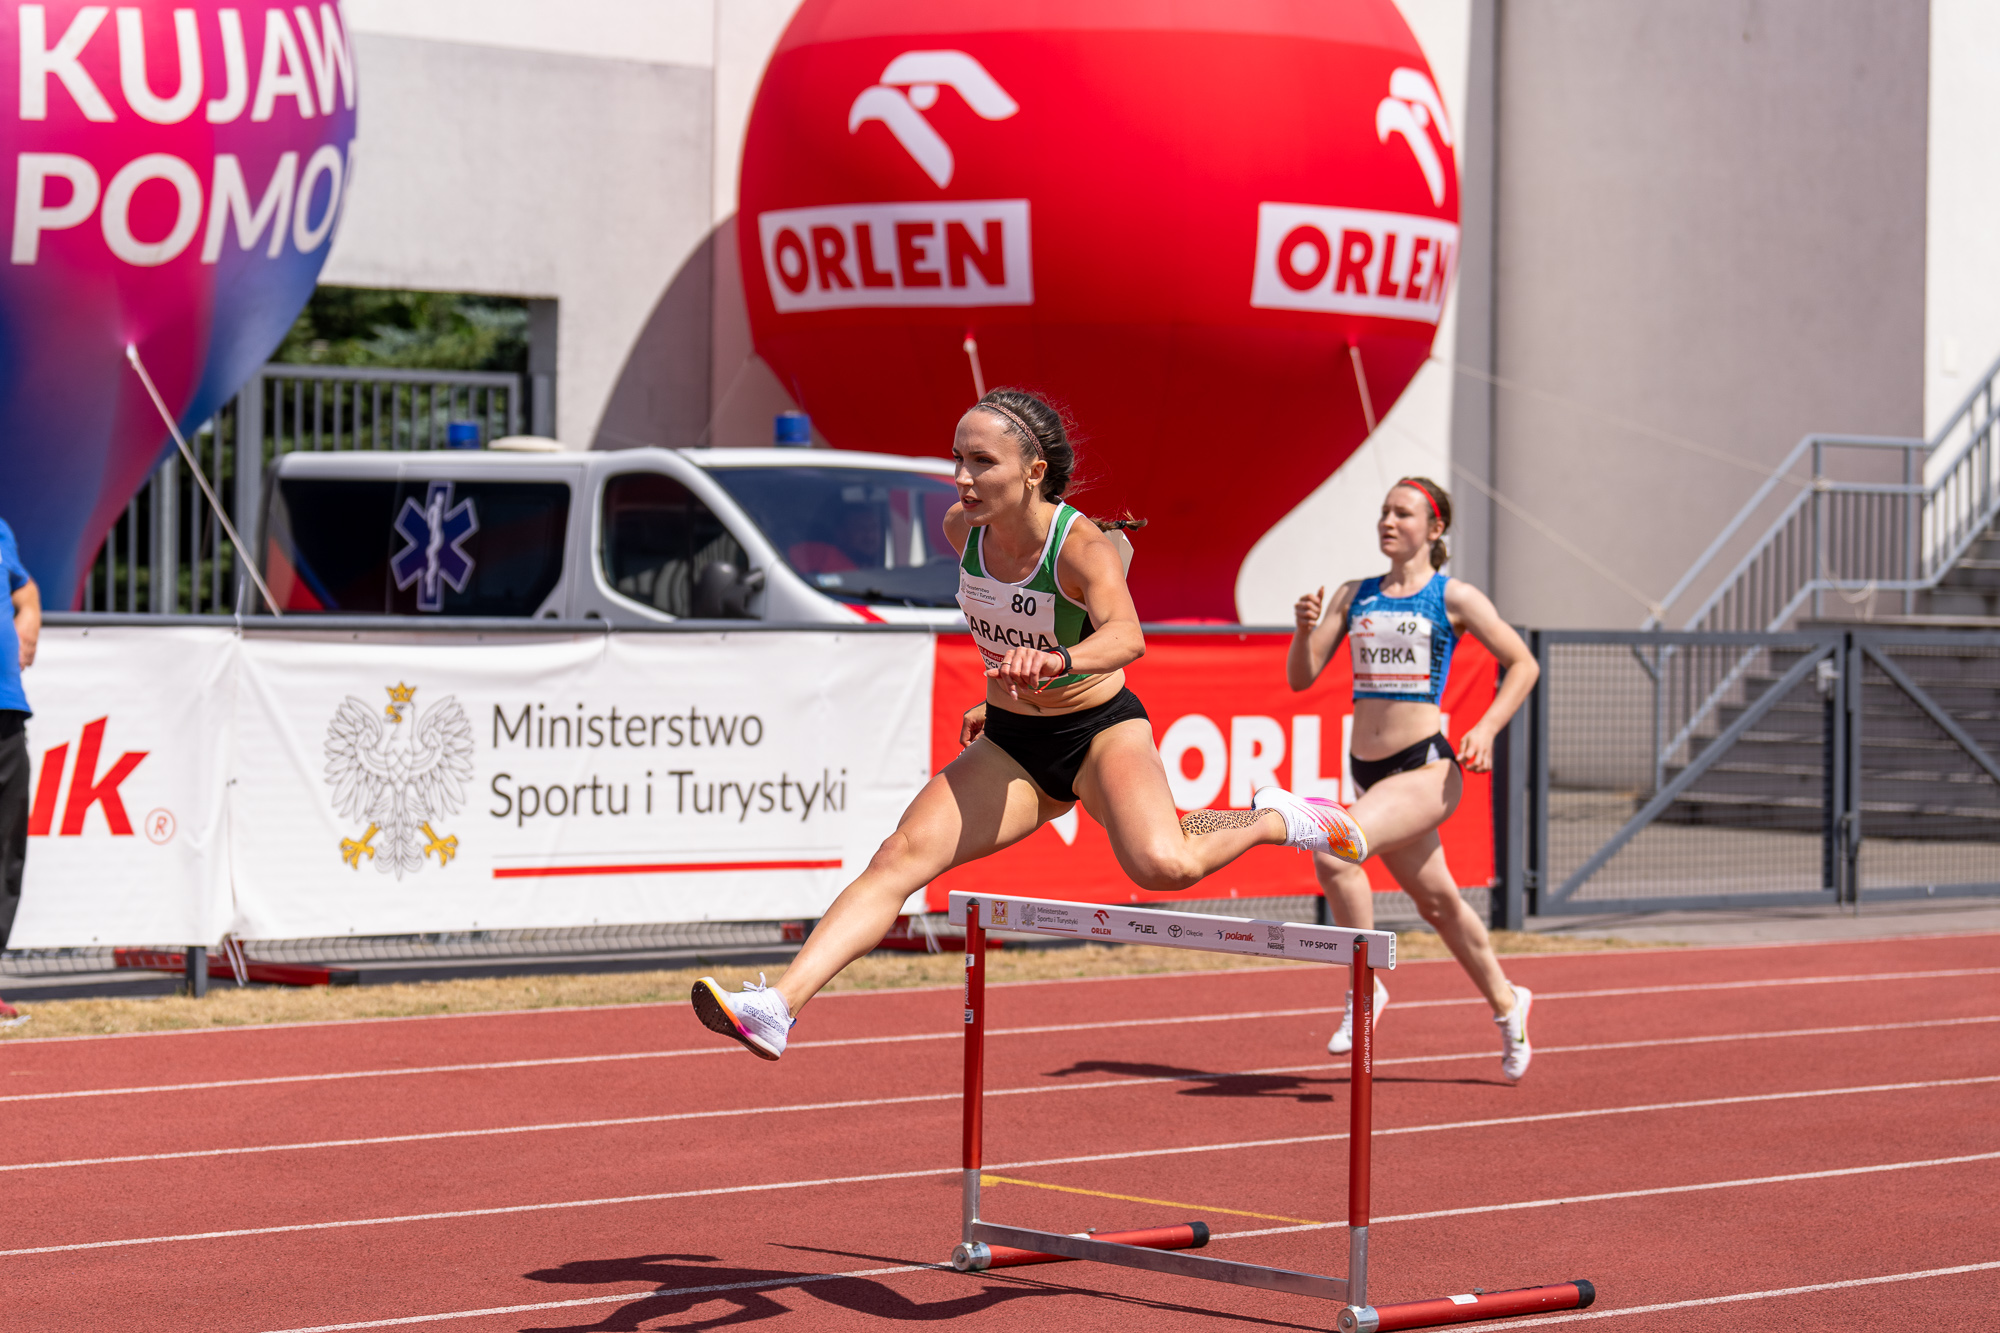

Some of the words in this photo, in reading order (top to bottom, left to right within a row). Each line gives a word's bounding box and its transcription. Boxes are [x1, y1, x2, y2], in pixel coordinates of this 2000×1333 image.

[11, 139, 357, 267] POMO
[772, 218, 1006, 296] ORLEN
[1275, 222, 1453, 304] ORLEN
[1011, 593, 1036, 616] 80
[964, 611, 1053, 650] ARACHA
[1396, 621, 1417, 635] 49
[1360, 648, 1416, 664] RYBKA
[492, 702, 764, 748] Ministerstwo
[490, 772, 628, 828] Sportu
[645, 769, 653, 815] i
[667, 768, 847, 823] Turystyki
[1037, 907, 1068, 916] Ministerstwo
[1037, 915, 1053, 923] Sportu
[1057, 917, 1078, 926] Turystyki
[1091, 927, 1111, 935] ORLEN
[1135, 924, 1157, 934] FUEL
[1225, 931, 1254, 942] polanik
[1299, 940, 1314, 948] TVP
[1314, 941, 1338, 950] SPORT
